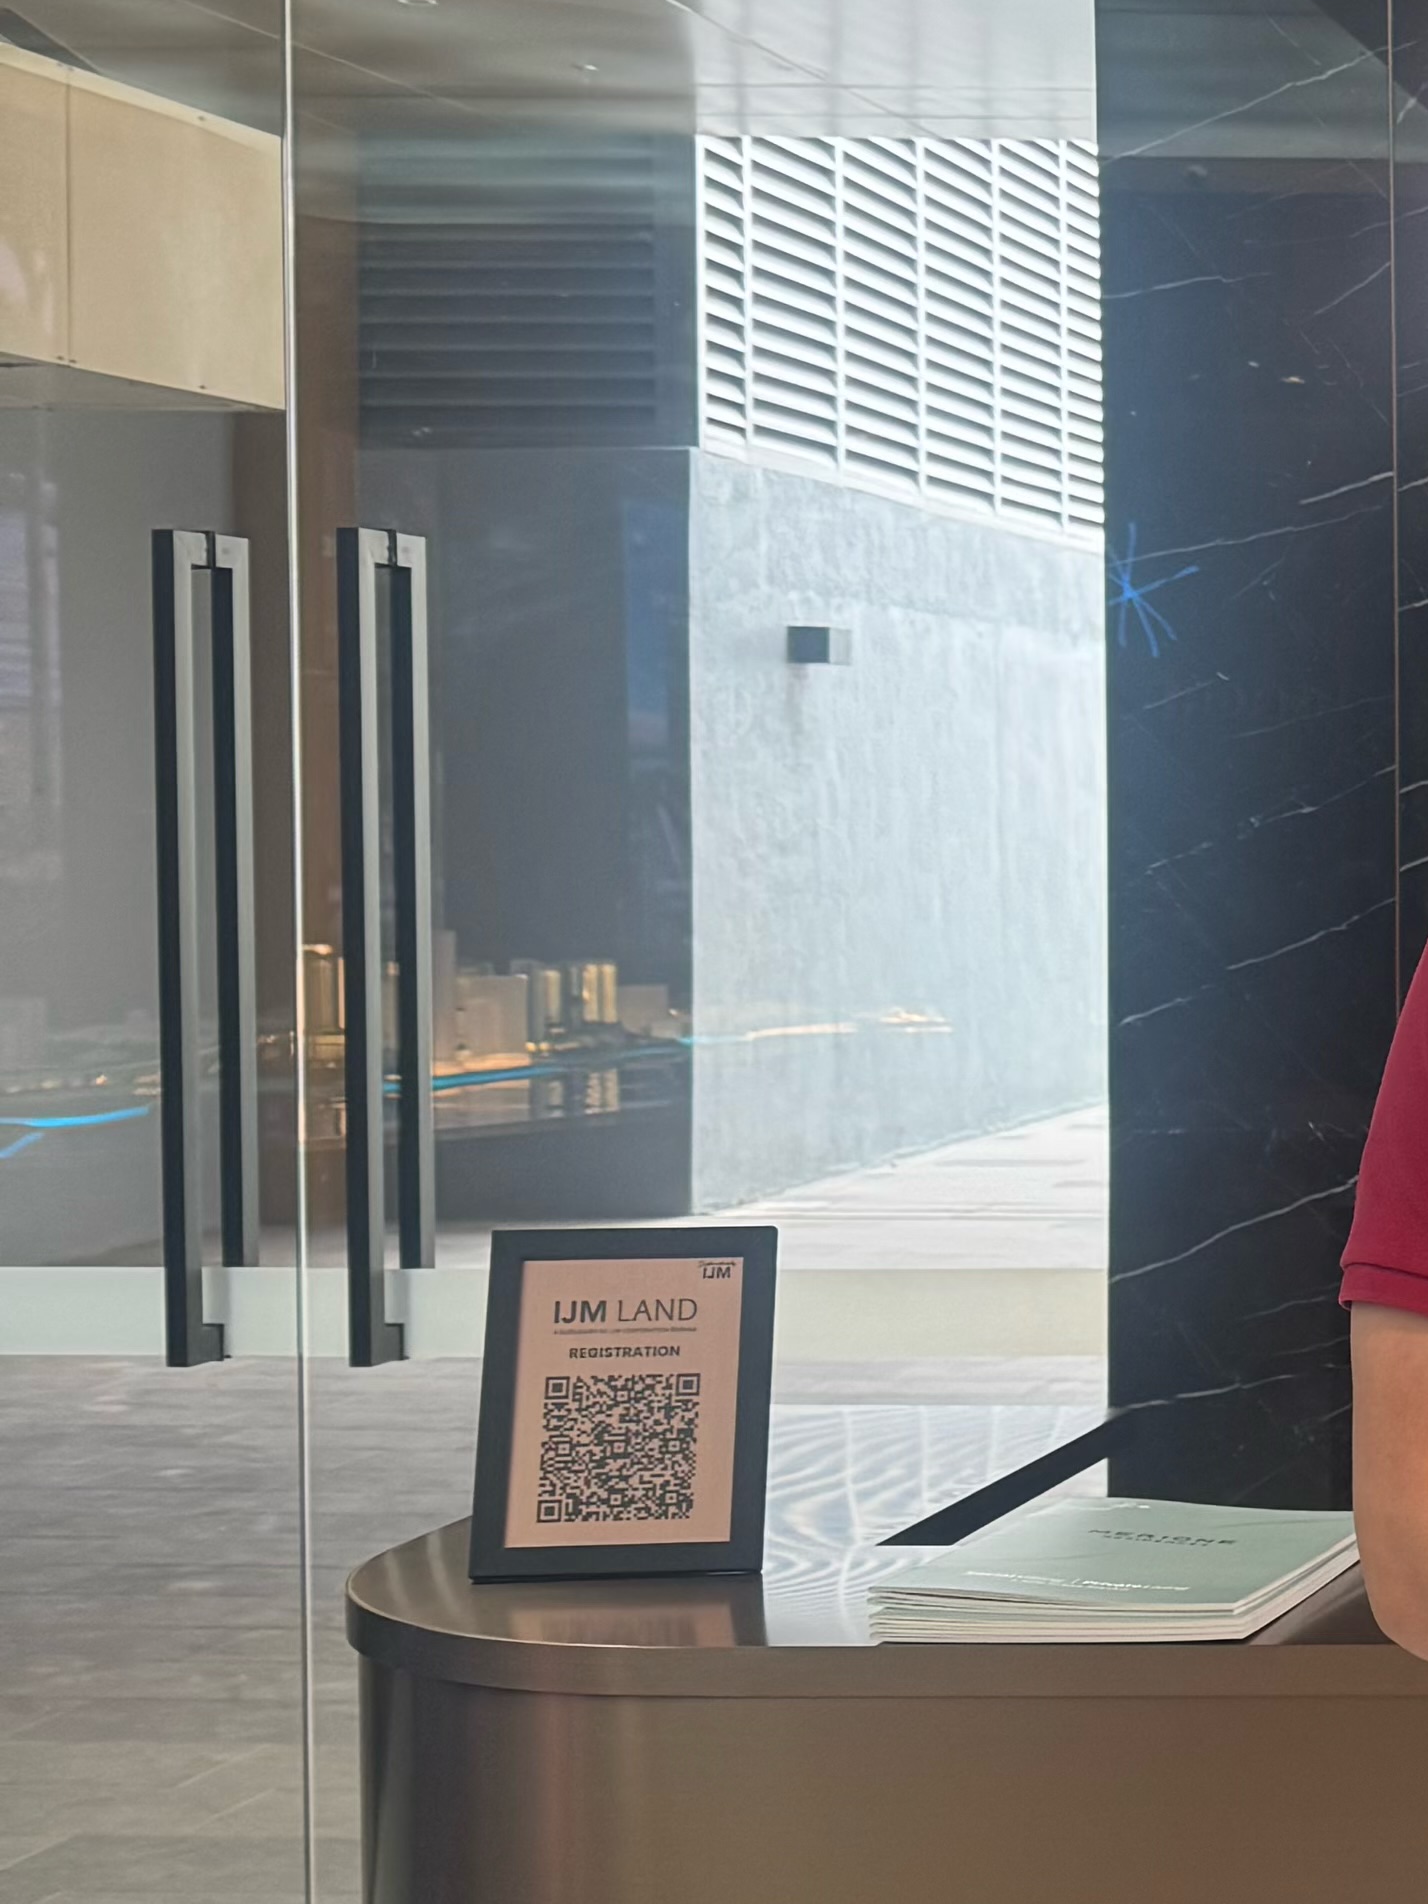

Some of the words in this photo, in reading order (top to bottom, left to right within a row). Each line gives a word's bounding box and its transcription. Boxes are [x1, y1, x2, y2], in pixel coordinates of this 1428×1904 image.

[554, 1300, 607, 1324] IJM
[617, 1298, 698, 1322] LAND
[569, 1345, 681, 1359] REGISTRATION
